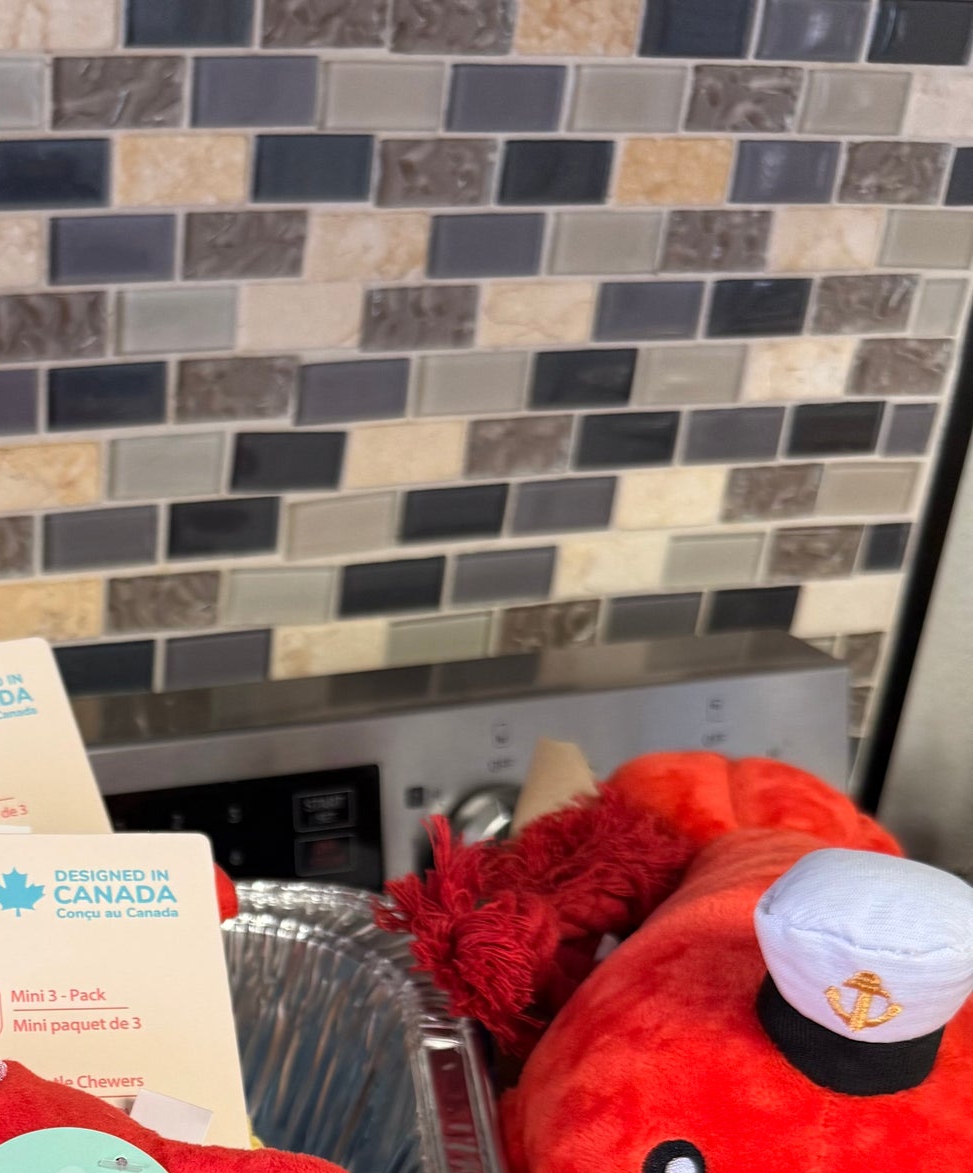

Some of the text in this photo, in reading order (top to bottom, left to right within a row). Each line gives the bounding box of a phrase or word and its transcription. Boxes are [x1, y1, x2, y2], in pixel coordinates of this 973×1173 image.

[7, 674, 24, 685] IN
[1, 804, 16, 818] de
[17, 804, 28, 816] 3
[54, 869, 170, 882] DESIGNED IN
[53, 885, 178, 905] CANADA
[56, 907, 179, 921] Conçu au Canada
[10, 988, 45, 1003] Mini
[48, 989, 58, 1002] 3
[70, 987, 107, 1002] Pack
[13, 1016, 142, 1035] Mini paquet de 3
[77, 1074, 145, 1090] Chewers
